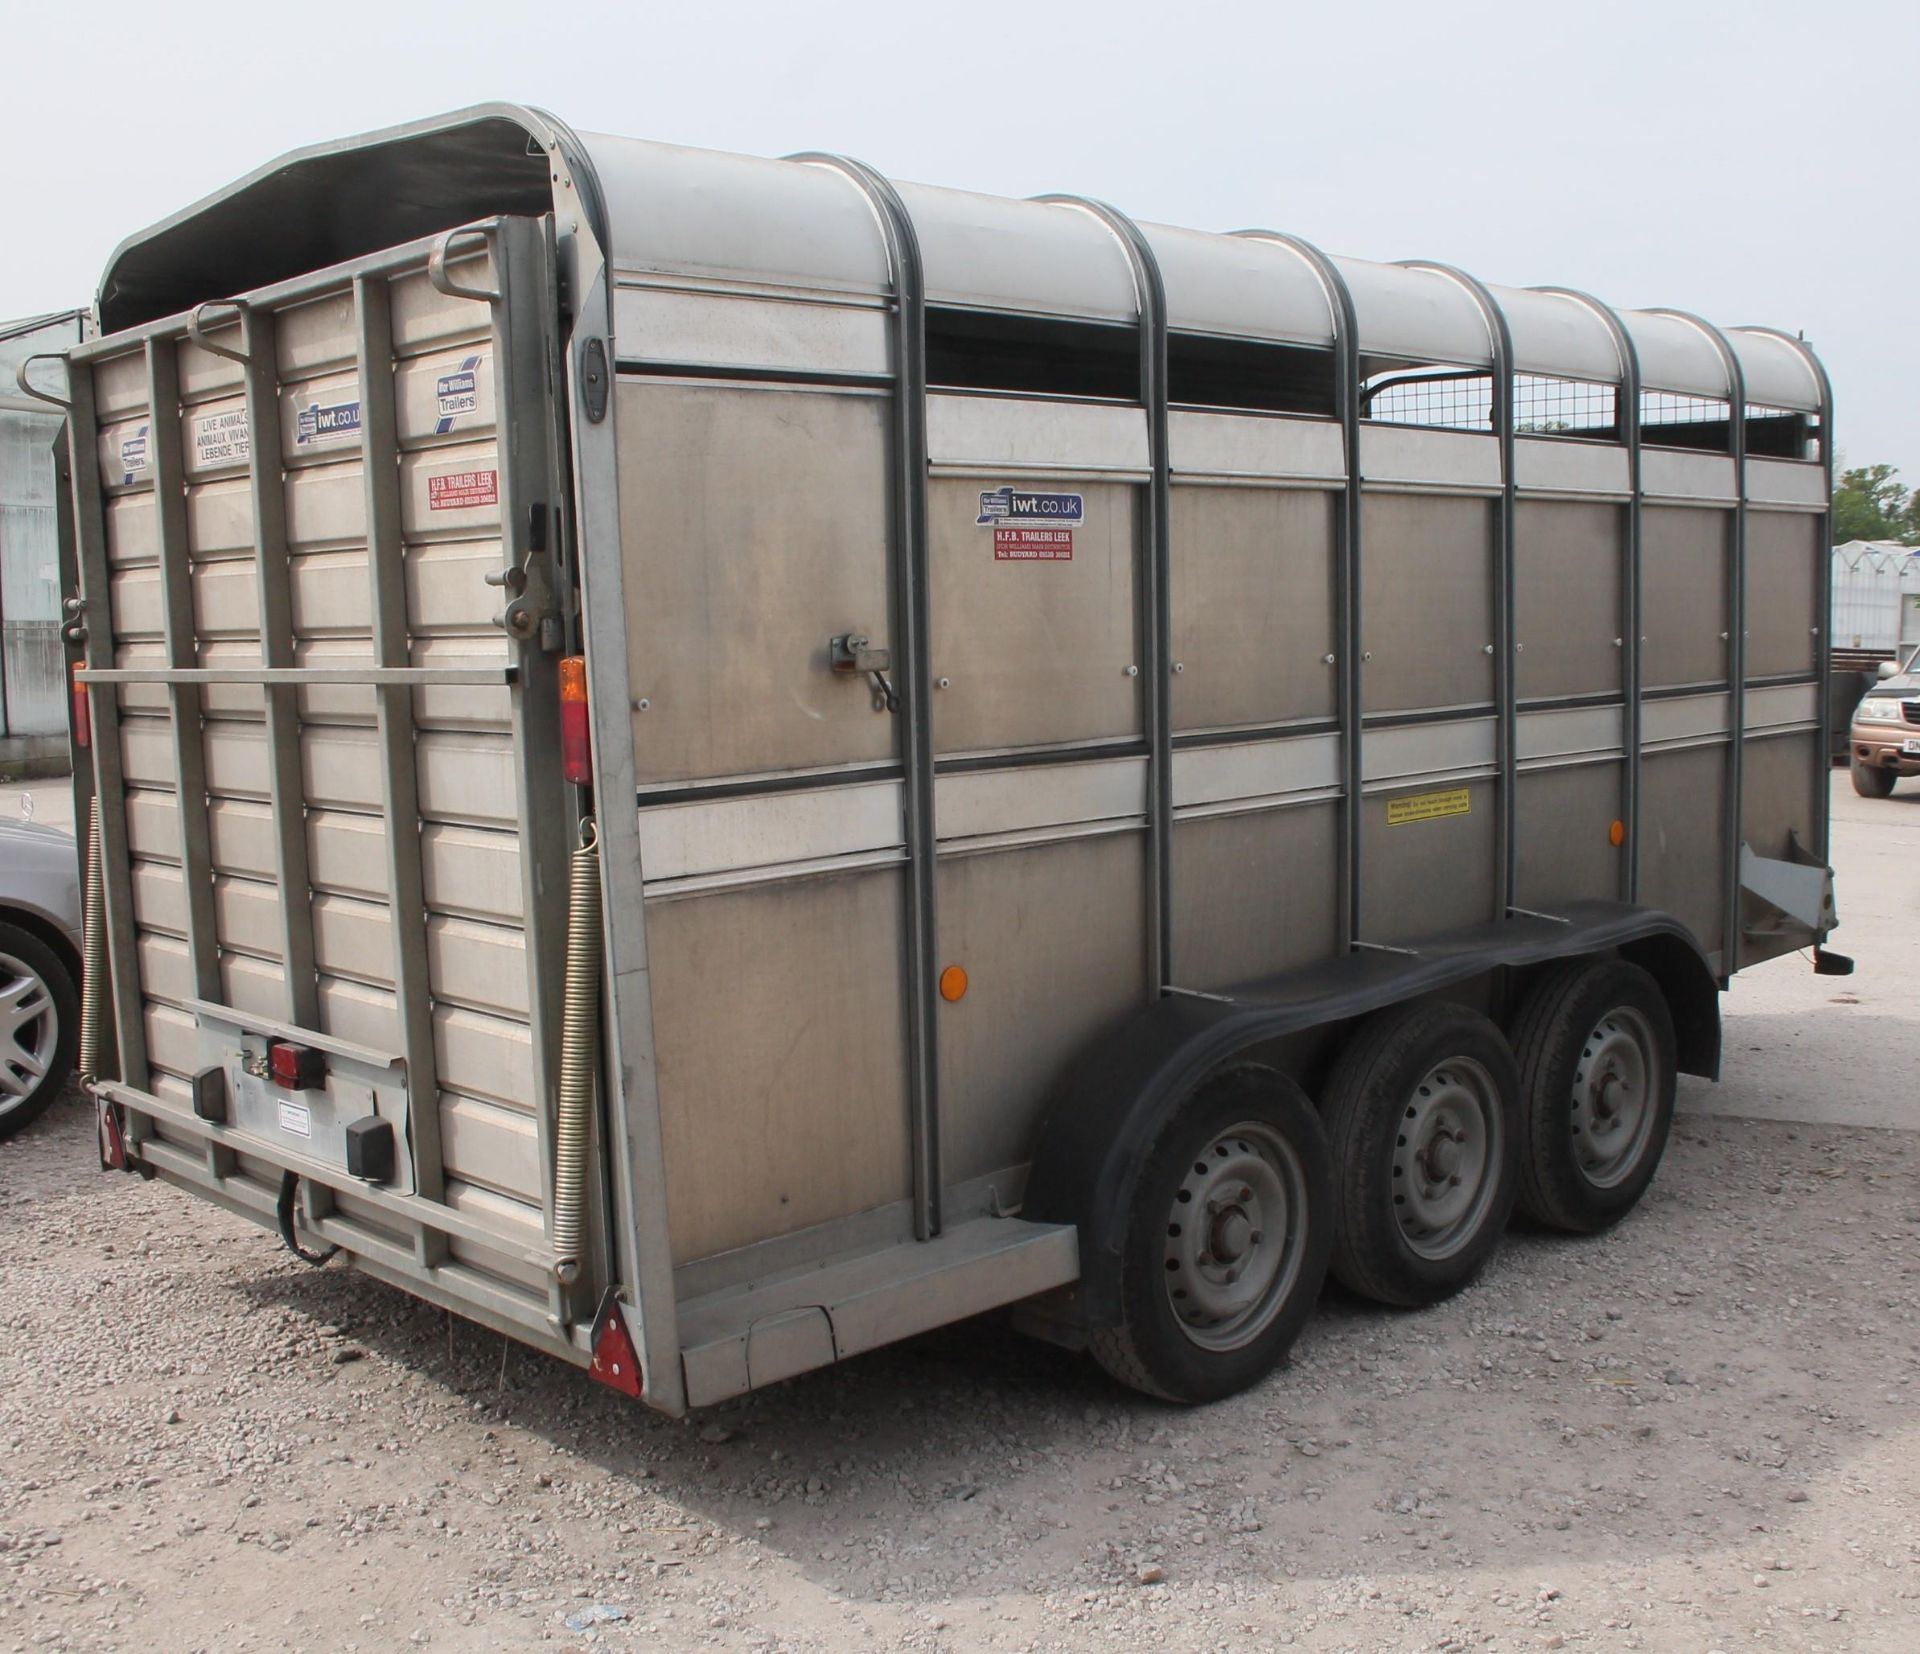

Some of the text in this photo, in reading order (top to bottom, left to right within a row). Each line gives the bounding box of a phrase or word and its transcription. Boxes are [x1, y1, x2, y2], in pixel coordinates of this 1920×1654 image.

[440, 396, 475, 411] Trailers
[203, 419, 217, 432] LIVE
[318, 410, 360, 429] iwt.co.u
[197, 432, 226, 448] ANIMAUX
[201, 445, 232, 460] LEBENDE
[447, 474, 477, 489] TRAILERS
[477, 472, 493, 486] LEEK
[1012, 496, 1078, 514] iwt.co.uk
[996, 531, 1070, 542] H.F.B. TRAILERS LEEK
